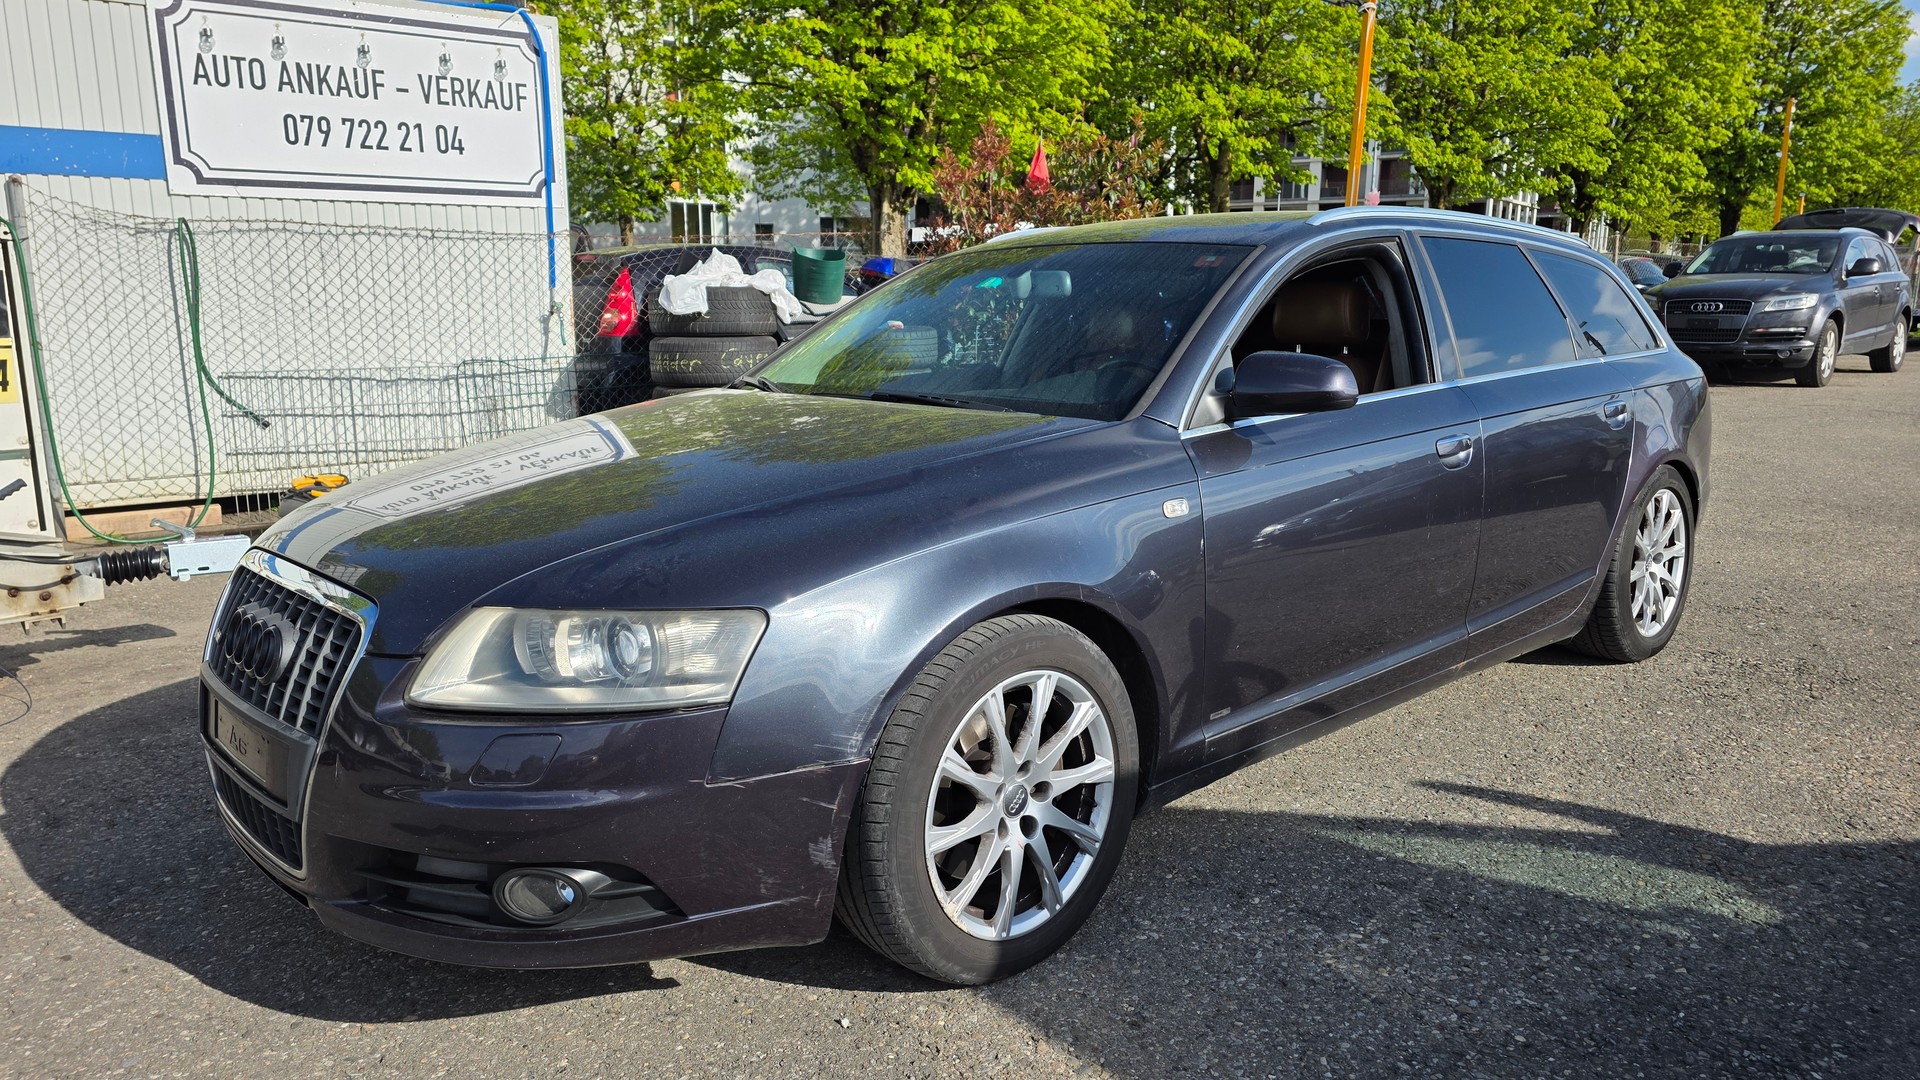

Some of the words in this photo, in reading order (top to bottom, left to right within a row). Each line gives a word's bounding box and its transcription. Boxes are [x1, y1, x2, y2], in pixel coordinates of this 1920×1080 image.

[193, 53, 267, 91] AUTO
[278, 60, 385, 100] ANKAUF
[417, 73, 527, 111] VERKAUF
[283, 113, 331, 147] 079
[341, 117, 389, 150] 722
[397, 121, 424, 153] 21
[436, 124, 465, 155] 04
